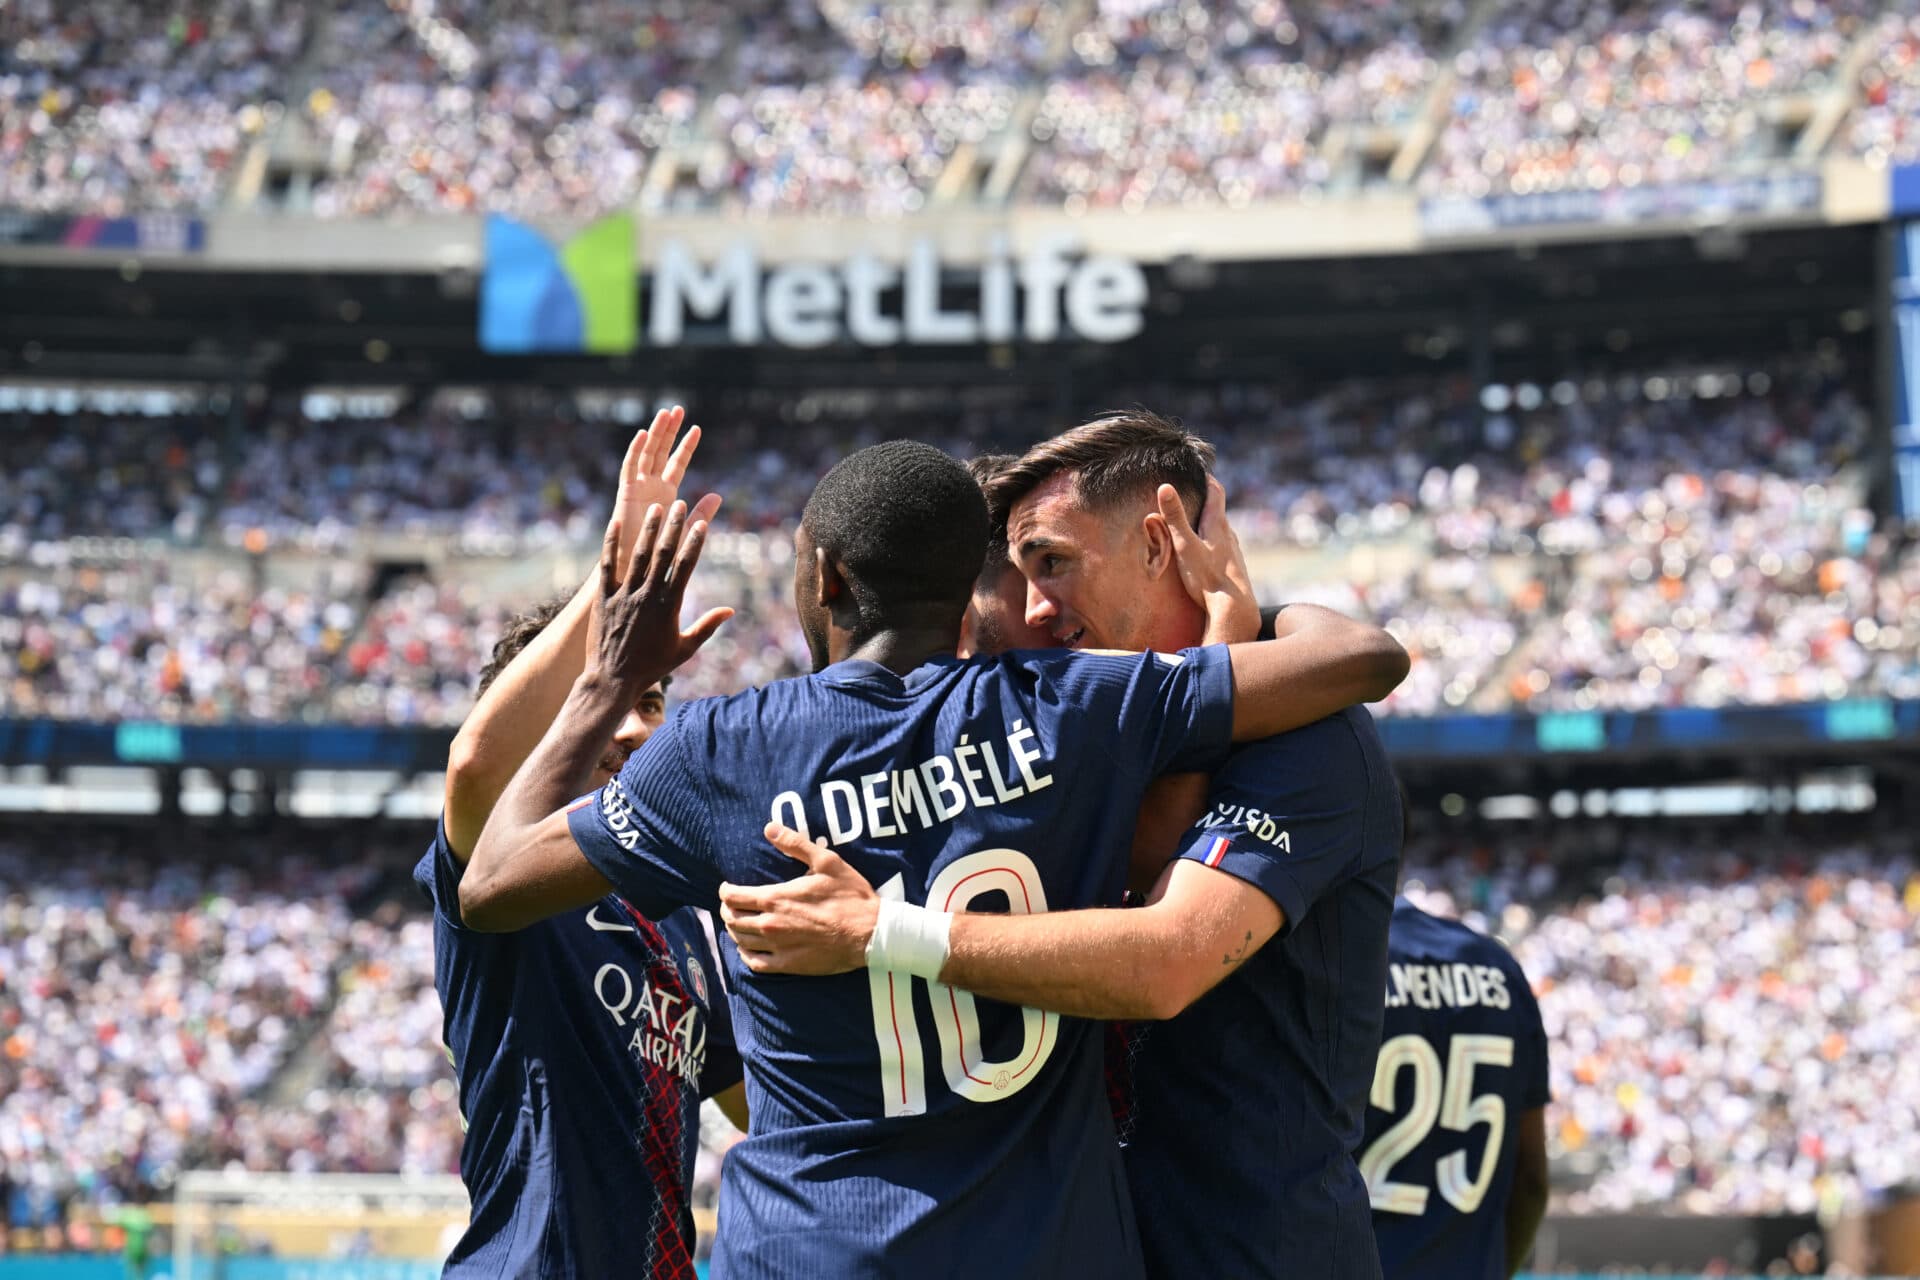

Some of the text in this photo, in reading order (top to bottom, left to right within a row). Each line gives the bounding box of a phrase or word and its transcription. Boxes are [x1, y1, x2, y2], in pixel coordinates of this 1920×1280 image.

[648, 234, 1147, 346] MetLife
[867, 848, 1060, 1118] 10
[1385, 962, 1512, 1010] .MENDES
[1359, 1033, 1514, 1216] 25
